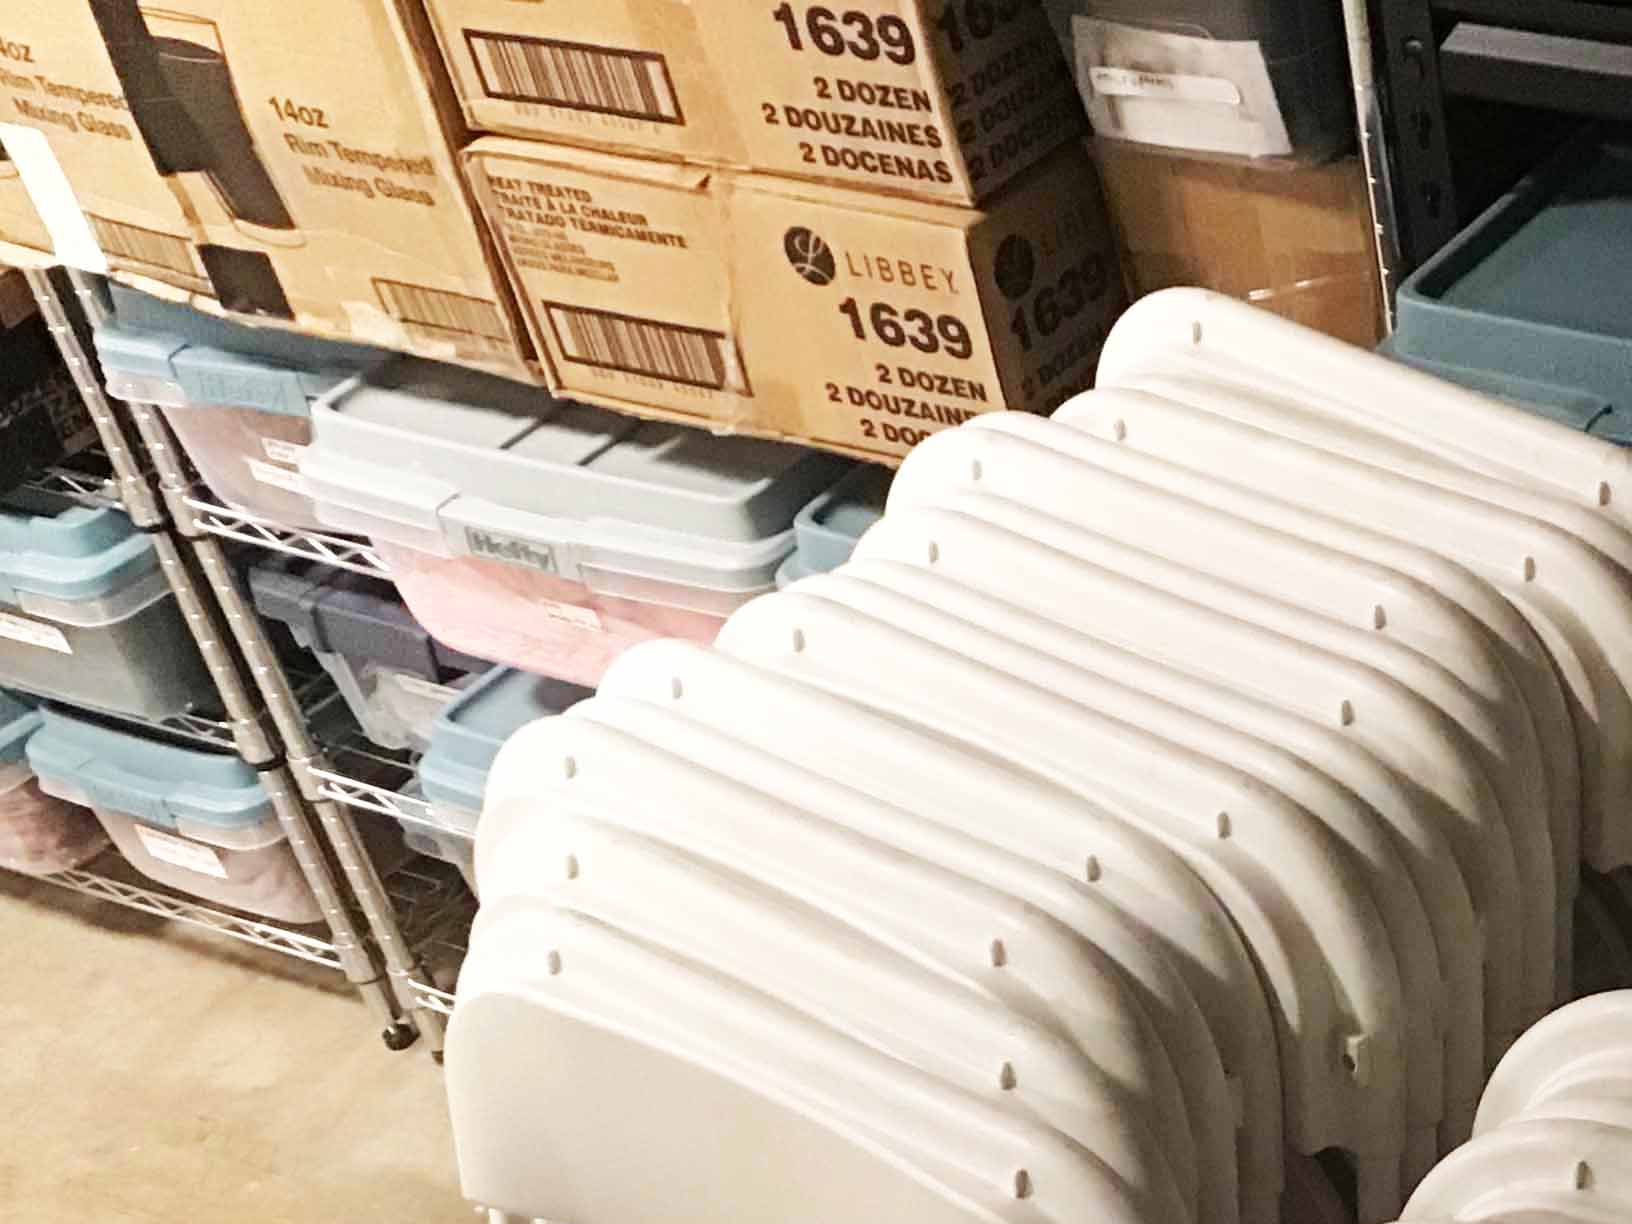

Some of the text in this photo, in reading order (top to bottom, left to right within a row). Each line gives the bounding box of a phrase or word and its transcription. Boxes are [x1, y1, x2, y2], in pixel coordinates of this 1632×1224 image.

[773, 1, 916, 65] 1639
[269, 96, 329, 129] 14oz
[813, 76, 932, 112] 2 DOZEN
[762, 102, 780, 125] 2
[784, 105, 943, 149] DOUZAINES
[283, 132, 435, 176] Rim Tempered
[799, 141, 953, 184] 2 DOCENAS
[845, 252, 959, 293] LIBBEY
[839, 297, 973, 360] 1639
[825, 382, 842, 403] 2
[875, 363, 988, 402] 2 DOZEN
[860, 418, 877, 438] 2
